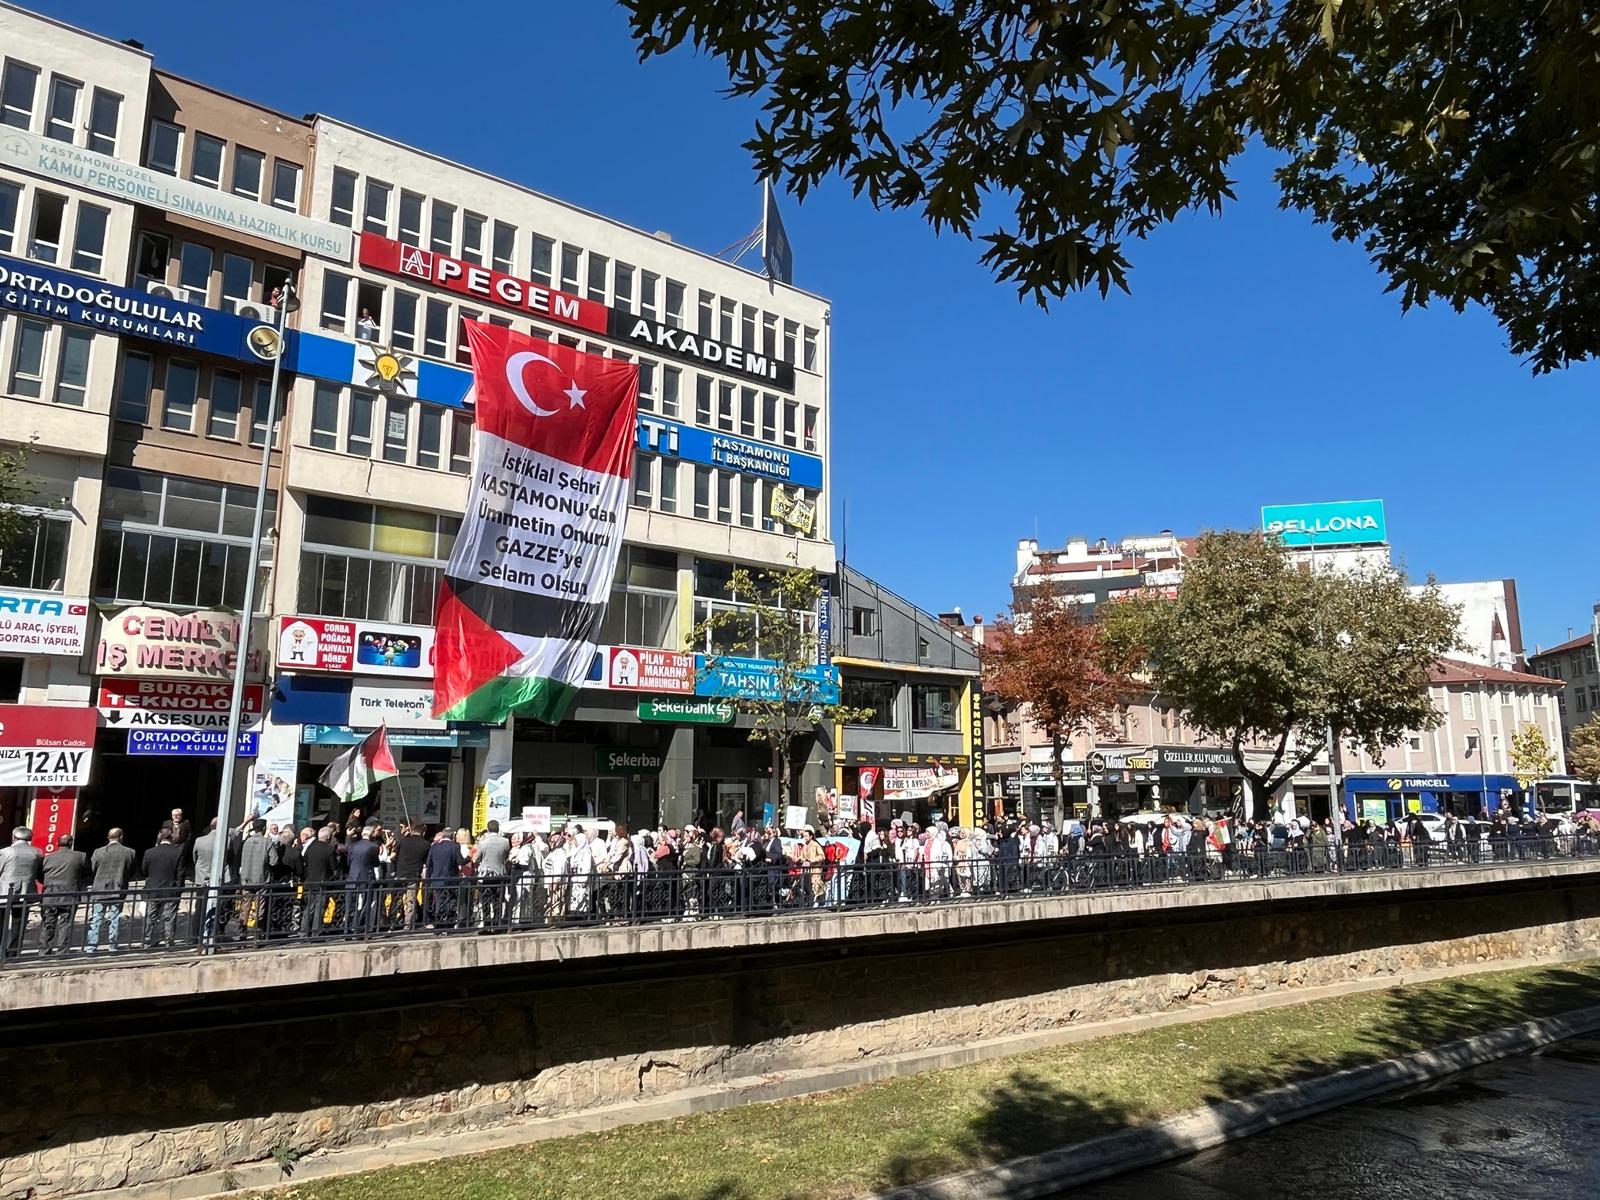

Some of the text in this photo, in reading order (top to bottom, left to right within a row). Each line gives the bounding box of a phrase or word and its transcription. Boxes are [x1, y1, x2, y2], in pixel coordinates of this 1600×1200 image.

[38, 156, 341, 254] KAMU PERSONELİ SINAVINA HAZIRLIK KURSU
[438, 258, 579, 321] PEGEM
[0, 288, 194, 344] ĞİTİM KURUMLARI
[713, 436, 790, 463] KASTAMONU
[502, 448, 601, 497] İstiklal Şehri
[726, 452, 790, 477] BAŞKANLIĞI
[479, 498, 610, 548] Ümmetin Onuru
[1268, 515, 1379, 533] BELLONA
[496, 536, 583, 570] GAZZE'ye
[479, 560, 588, 596] Selam Olsun
[14, 622, 44, 634] ARAÇ,
[46, 623, 79, 636] İŞYERİ,
[123, 614, 216, 640] CEMİL
[43, 637, 81, 647] YAPILIR.
[318, 644, 353, 654] KAHVALTI
[97, 639, 127, 670] İŞ
[639, 651, 665, 666] PİLAV
[672, 655, 693, 667] TOST
[644, 665, 688, 678] MAKARNA
[139, 682, 227, 696] BURAK
[639, 676, 681, 689] HAMBURGER
[106, 694, 254, 711] TEKNOLOİ
[360, 697, 425, 709] Türk Telekom
[651, 698, 715, 716] Şekerbank
[36, 738, 87, 747] Bülsan Cadde
[133, 730, 251, 744] ORTADOĞULUR
[137, 743, 251, 752] EĞİTİM KURUMRI
[25, 751, 50, 774] 12
[53, 751, 84, 774] AY
[27, 774, 78, 782] TAKSİTLE
[886, 780, 892, 789] 2
[1404, 779, 1450, 788] TURKCELL
